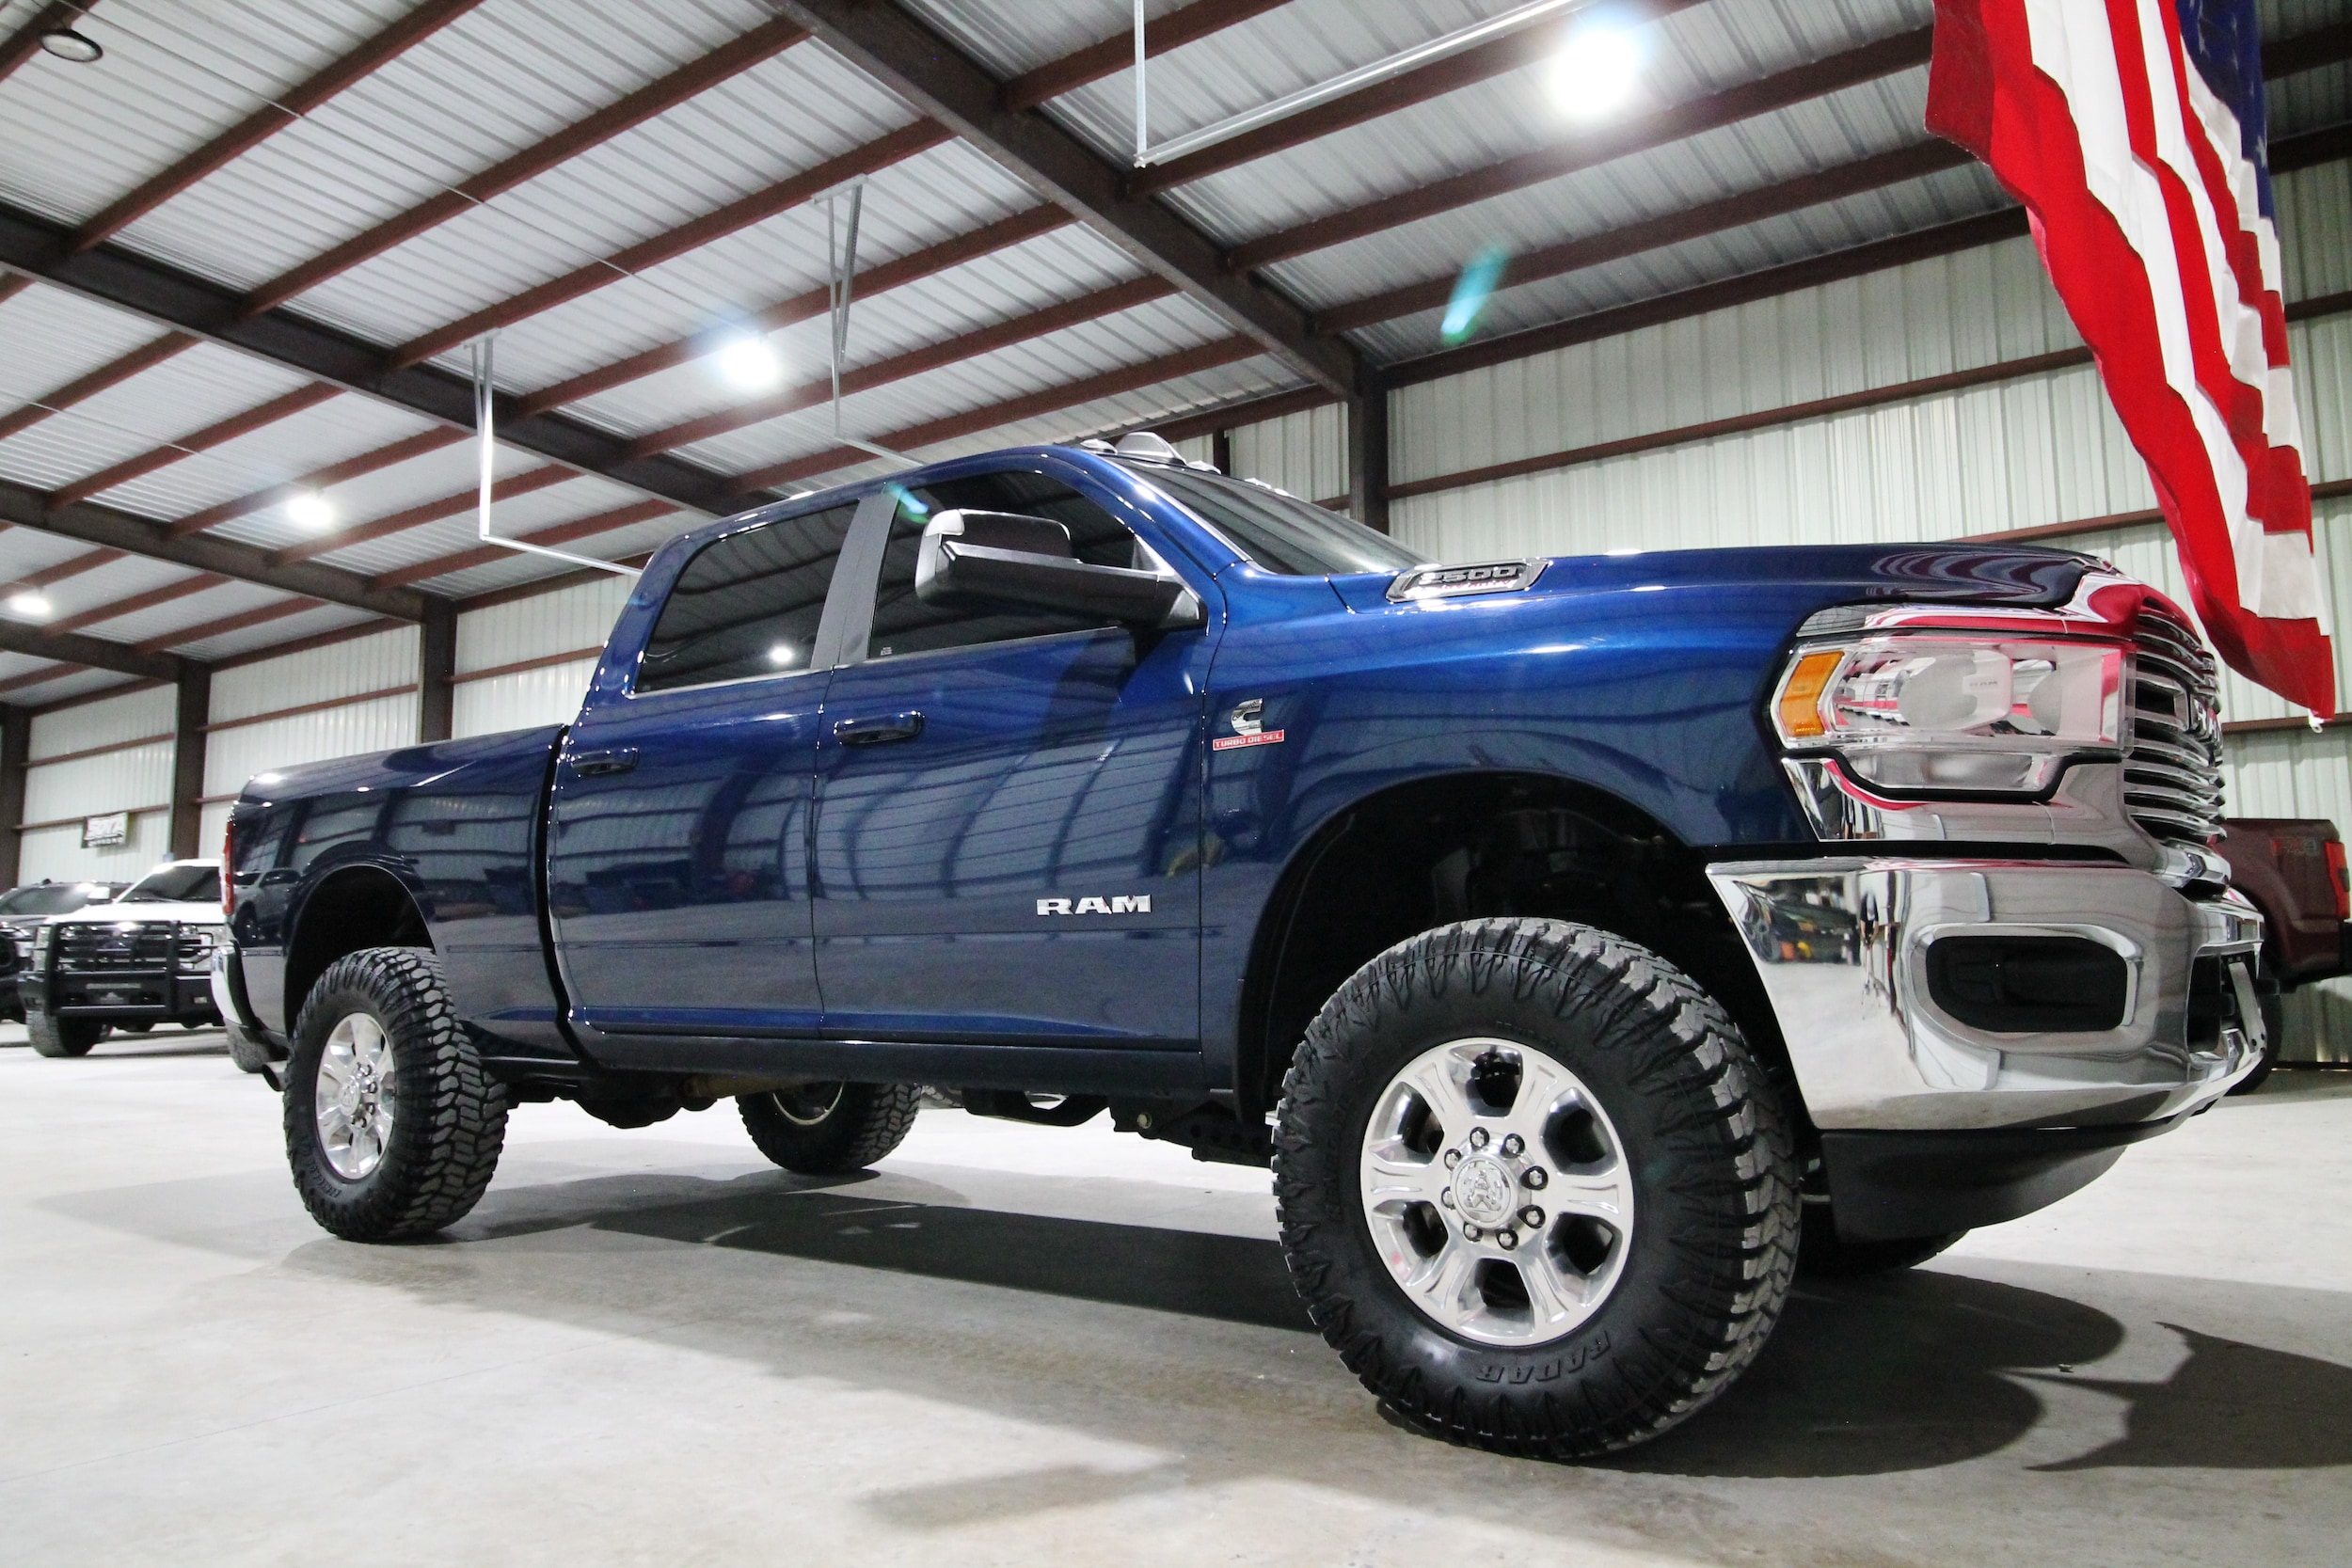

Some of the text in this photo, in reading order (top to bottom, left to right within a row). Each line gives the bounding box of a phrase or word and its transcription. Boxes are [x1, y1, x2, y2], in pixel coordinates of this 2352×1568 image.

[1215, 733, 1282, 748] TURBO DIESEL
[1037, 895, 1152, 915] RAM
[1475, 1330, 1611, 1385] RADAR
